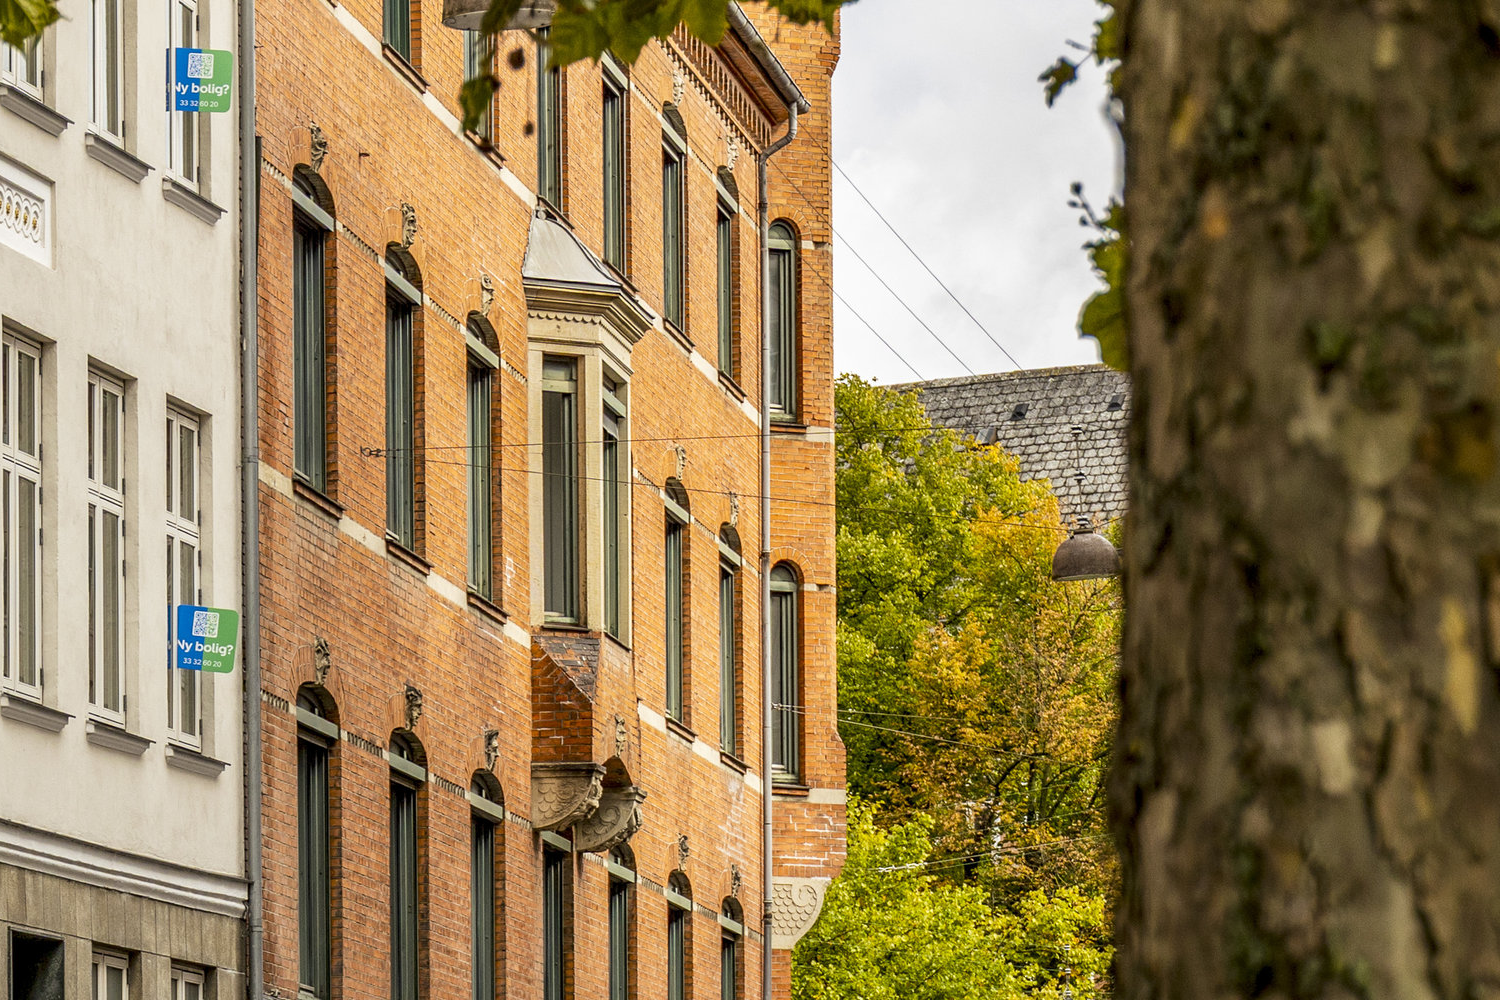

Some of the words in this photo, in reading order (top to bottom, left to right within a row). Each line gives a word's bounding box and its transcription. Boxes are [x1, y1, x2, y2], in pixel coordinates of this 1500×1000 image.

[191, 82, 229, 96] bolig?
[177, 639, 193, 652] Ny
[195, 641, 234, 656] bolig?
